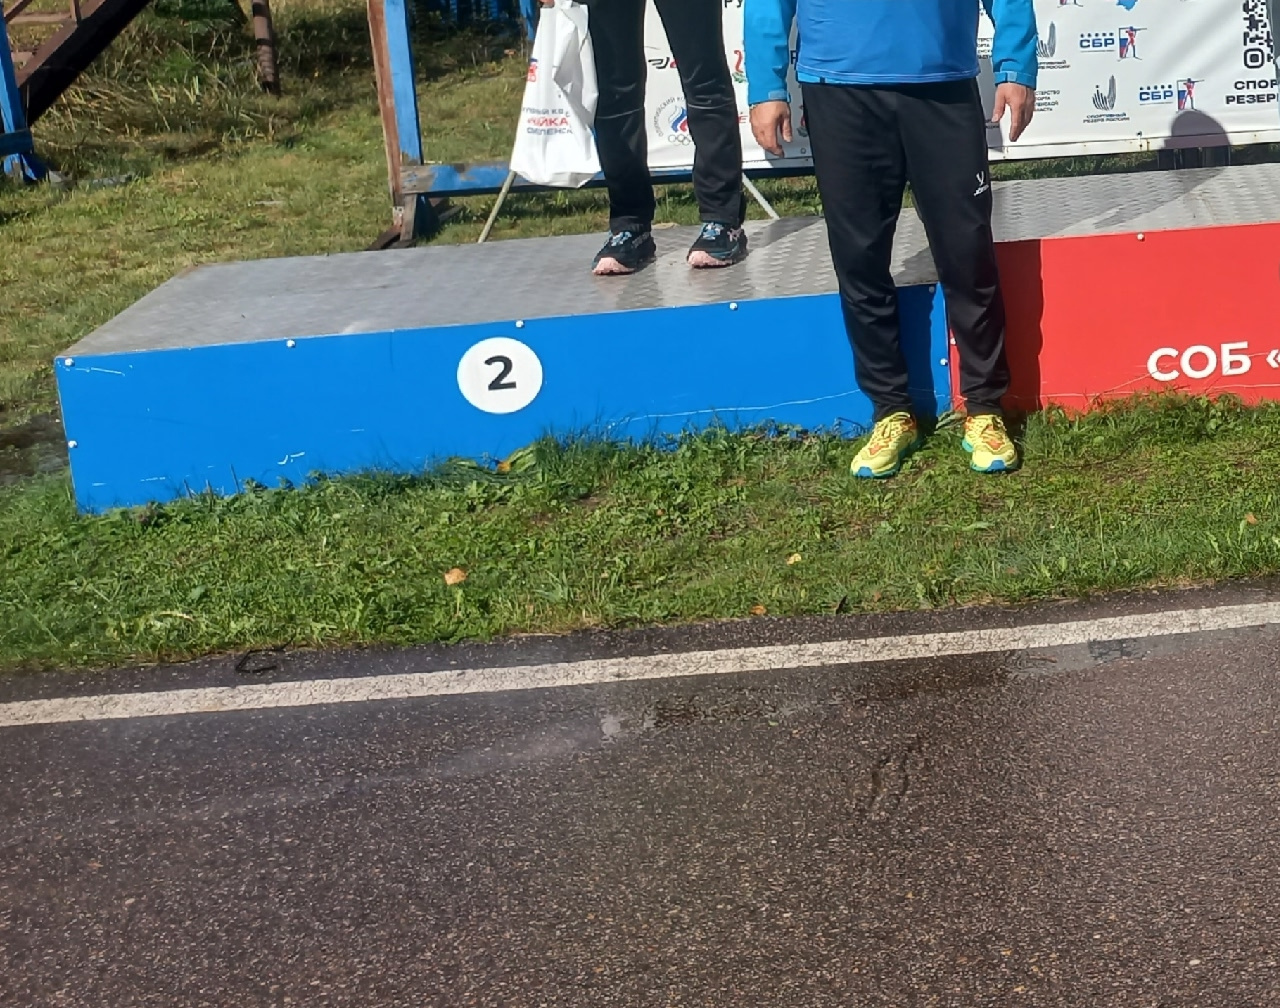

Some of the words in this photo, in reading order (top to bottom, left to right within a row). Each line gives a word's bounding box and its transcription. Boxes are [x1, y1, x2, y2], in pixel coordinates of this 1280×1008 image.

[1079, 38, 1115, 48] СБР
[1139, 90, 1174, 101] СБР
[484, 355, 517, 391] 2
[1147, 342, 1252, 382] СОБ
